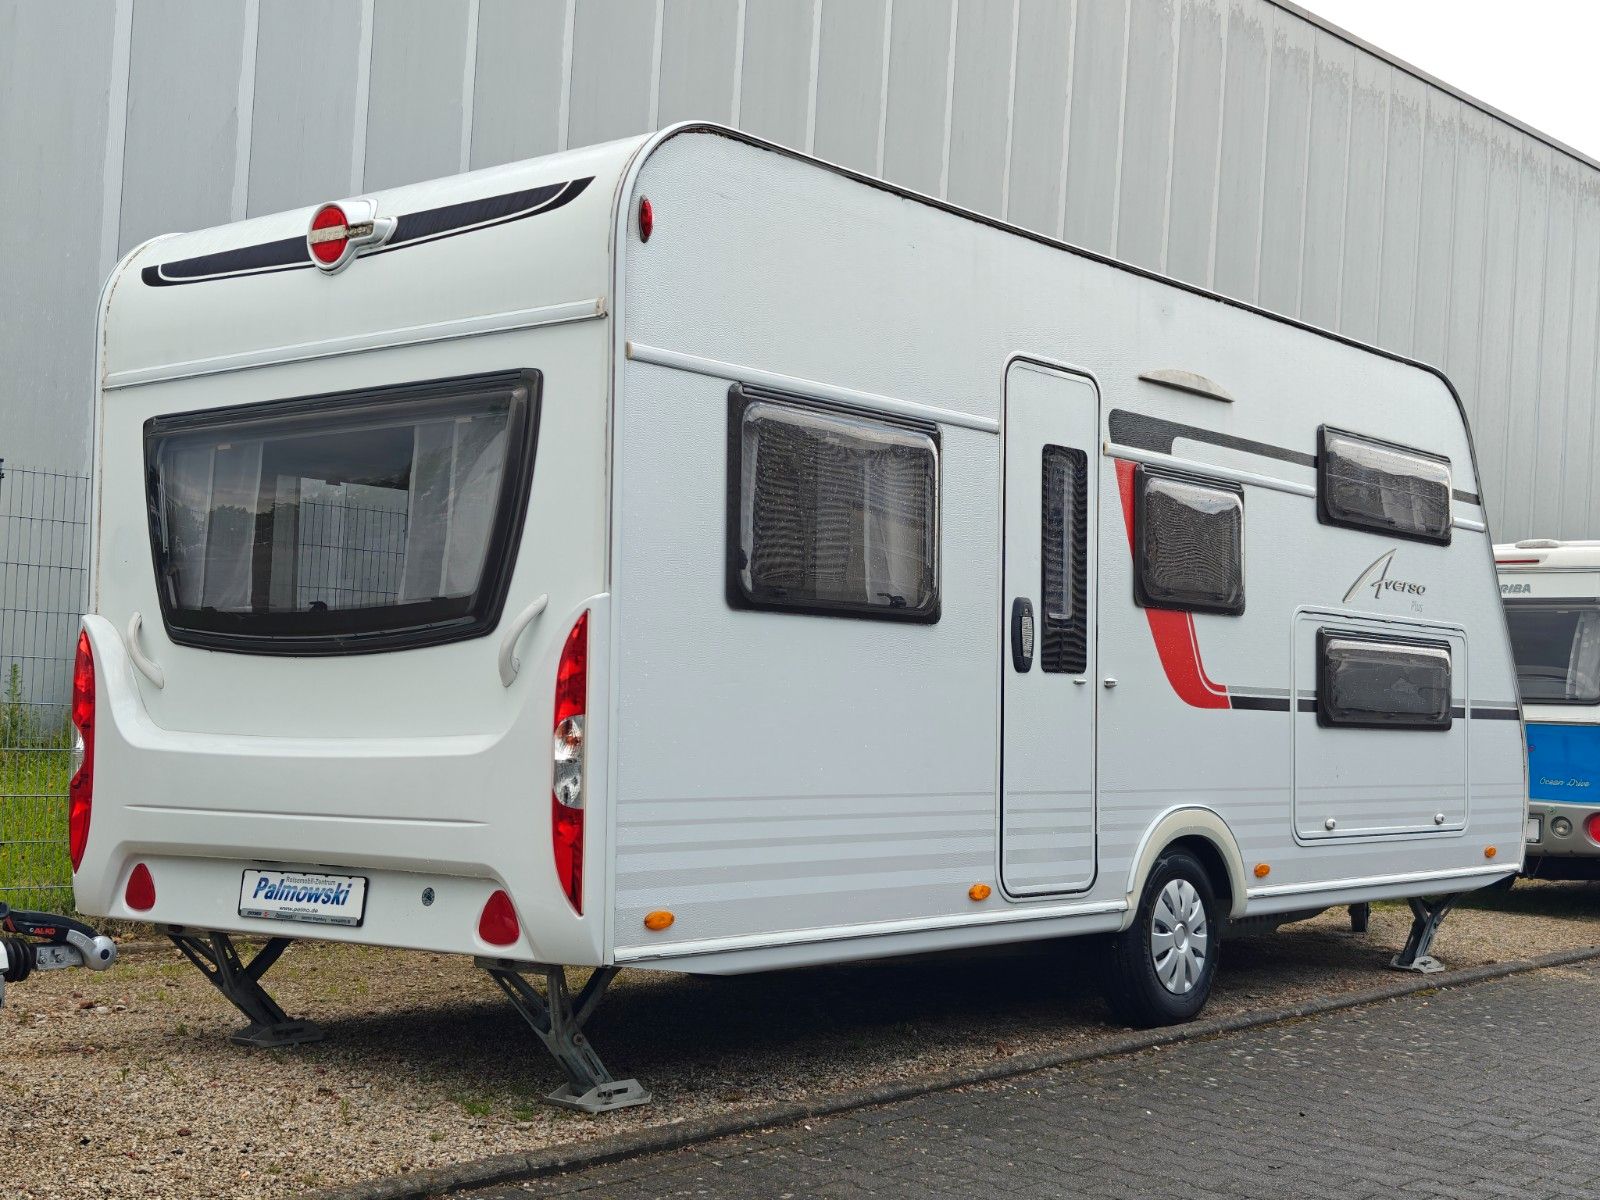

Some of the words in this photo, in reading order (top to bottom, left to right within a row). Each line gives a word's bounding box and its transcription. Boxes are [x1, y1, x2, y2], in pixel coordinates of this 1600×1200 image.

[1342, 548, 1426, 603] Averso
[1500, 583, 1531, 594] RIBA
[252, 876, 353, 906] Palmowski
